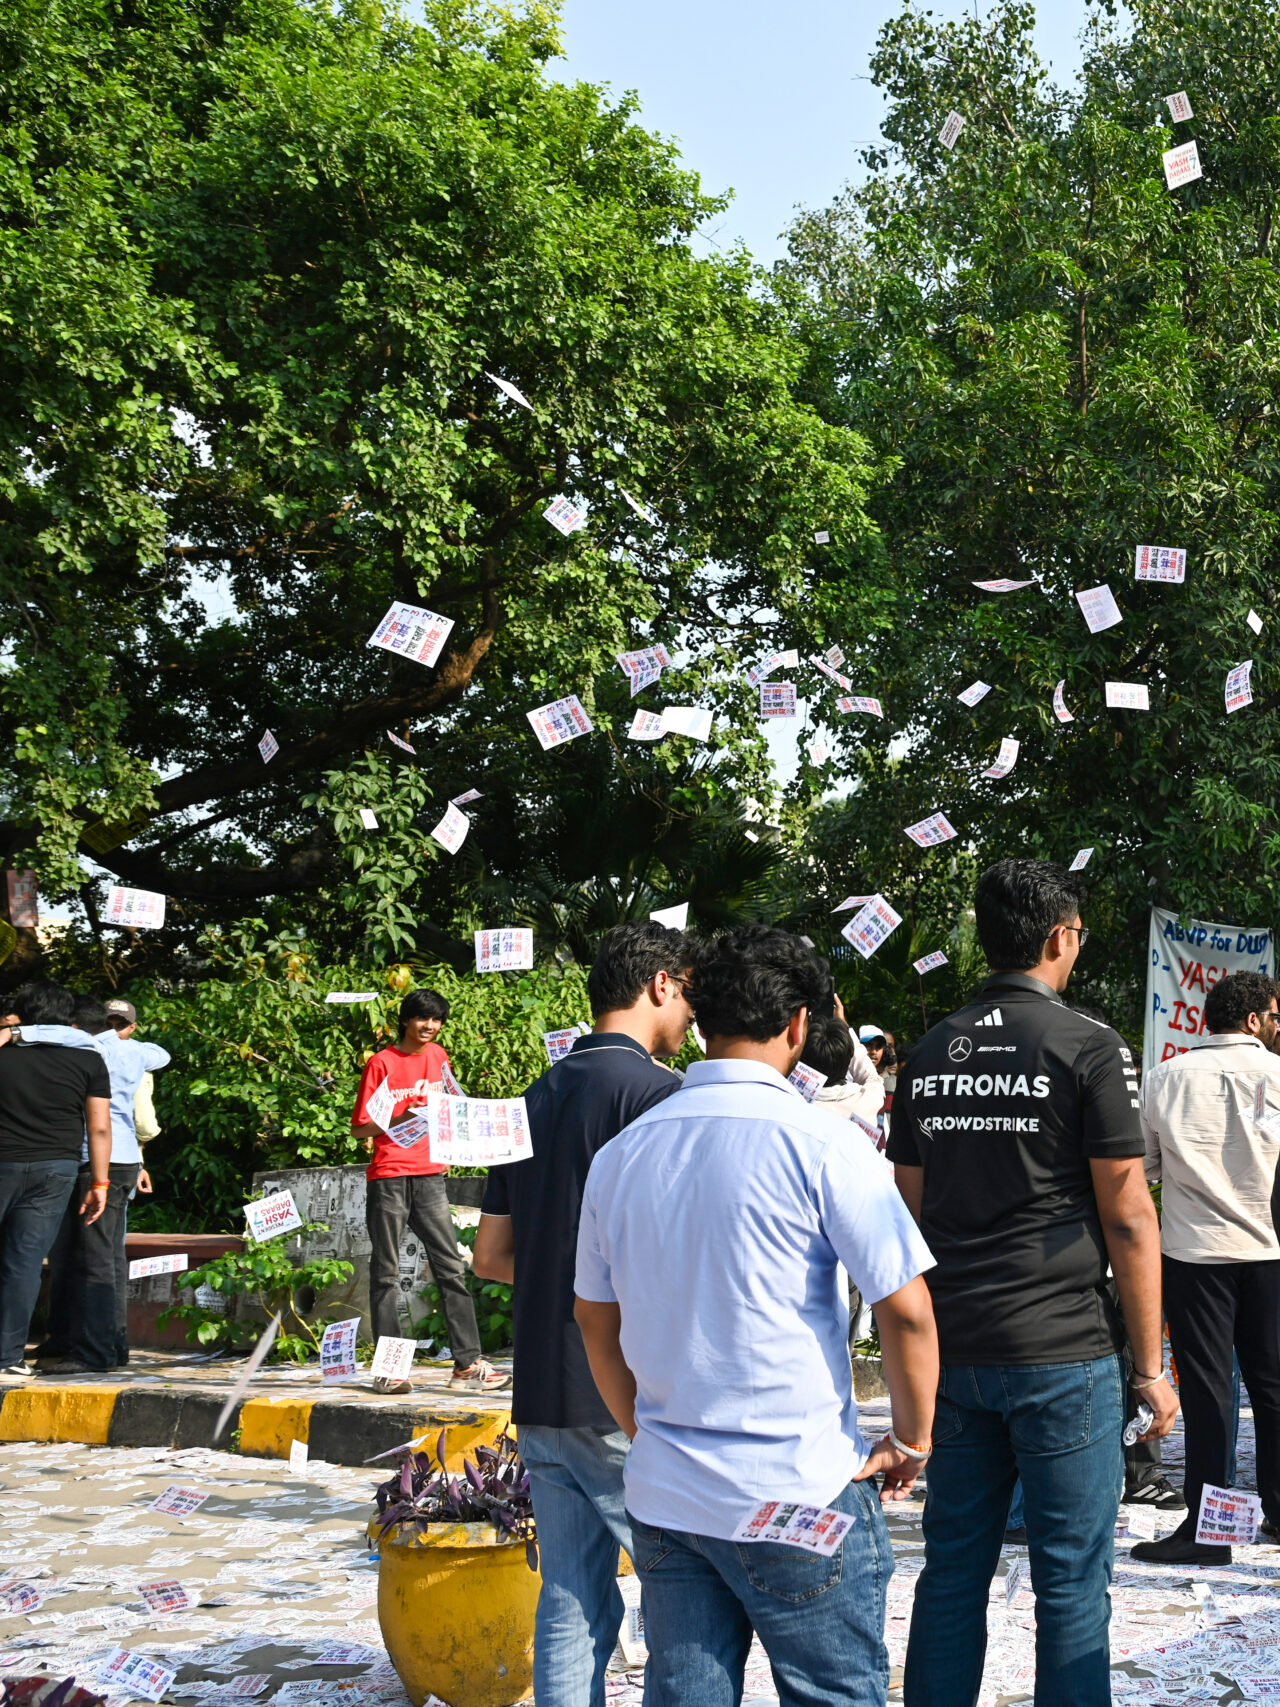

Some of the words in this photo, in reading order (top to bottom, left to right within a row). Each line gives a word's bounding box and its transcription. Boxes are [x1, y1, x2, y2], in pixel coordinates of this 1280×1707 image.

[1190, 156, 1196, 169] 7
[1164, 920, 1208, 948] ABVP
[1210, 929, 1232, 952] for
[912, 1073, 1050, 1100] PETRONAS
[924, 1116, 1040, 1133] CROWDSTRIKE
[261, 1200, 291, 1216] DABAAS
[265, 1208, 294, 1225] YASH
[254, 1212, 264, 1226] 7
